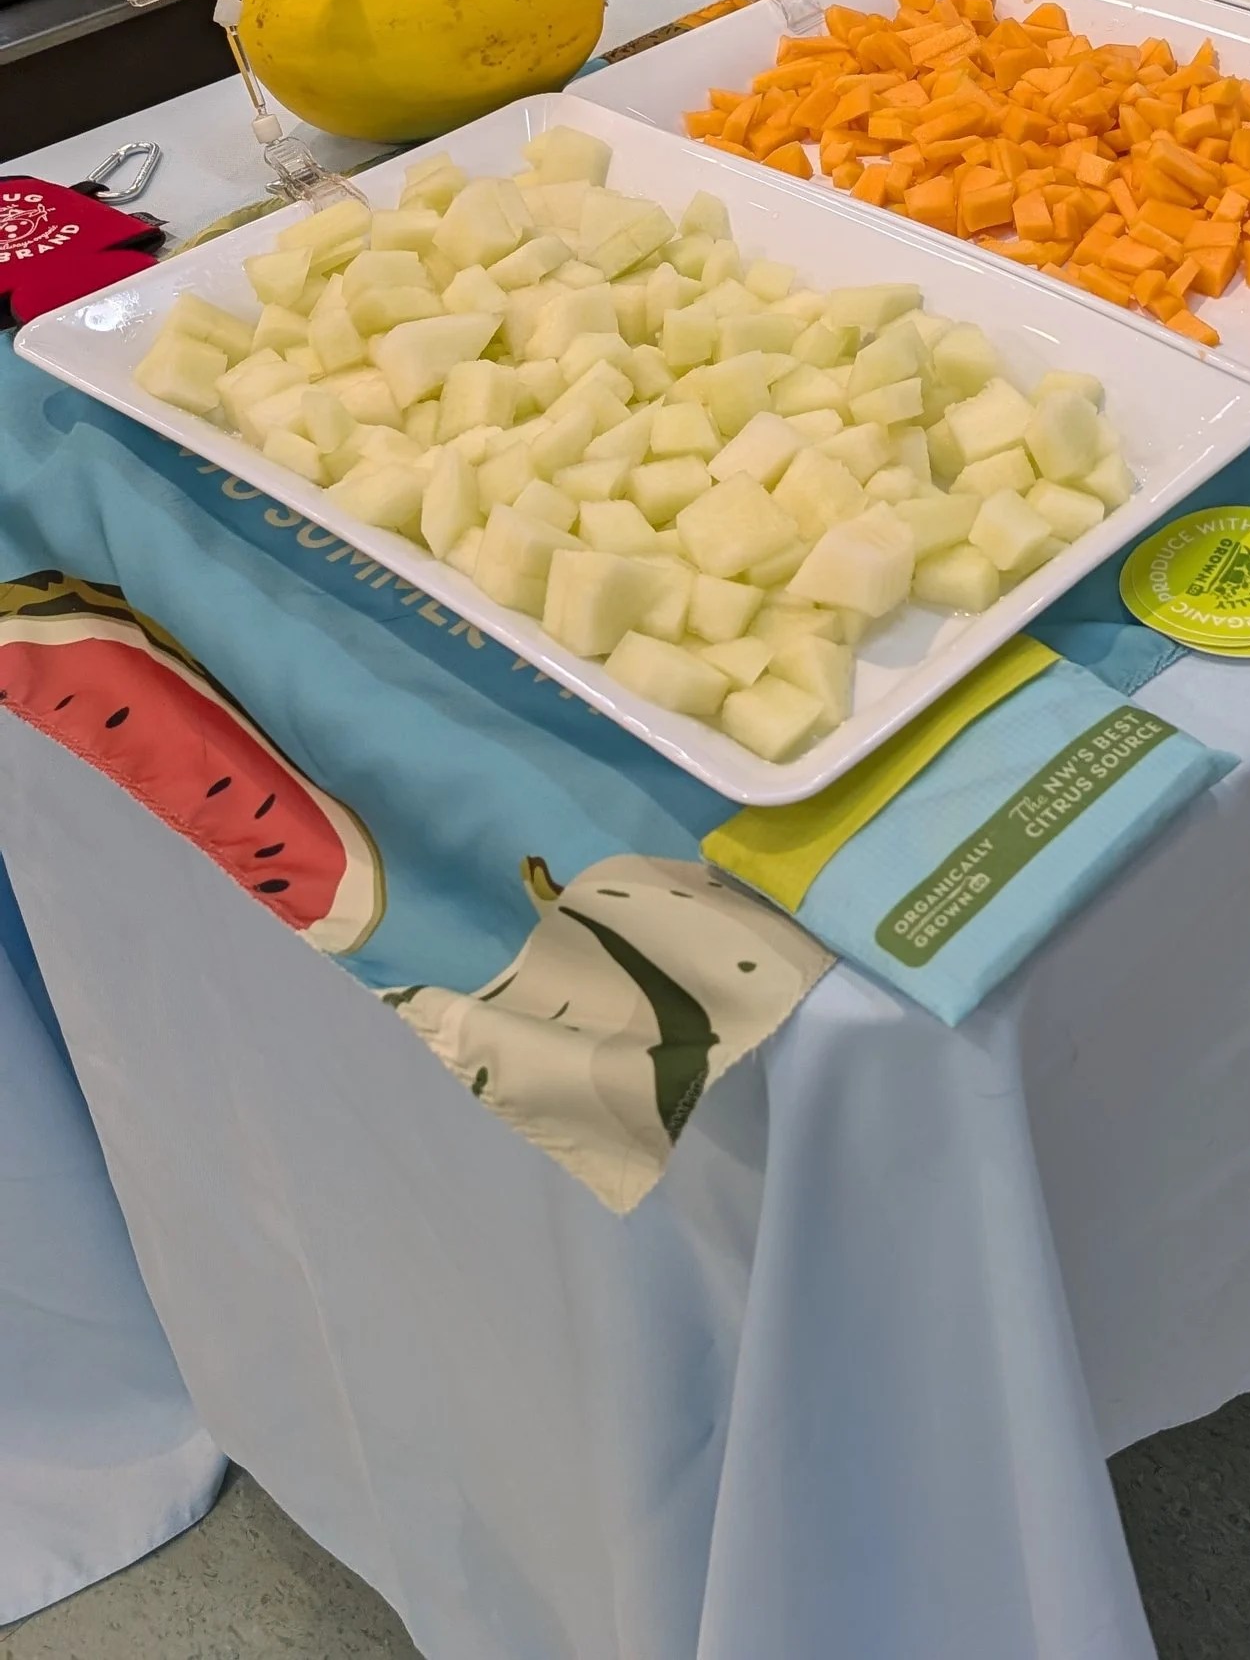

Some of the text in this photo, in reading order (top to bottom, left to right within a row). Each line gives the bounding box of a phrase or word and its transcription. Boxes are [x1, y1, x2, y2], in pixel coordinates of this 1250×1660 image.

[0, 224, 80, 263] BRAND
[1149, 529, 1194, 604] PRODUCE
[1196, 537, 1233, 591] GROWN
[1007, 712, 1141, 824] The NW'S BEST
[1024, 720, 1163, 839] CITRUS SOURCE
[893, 838, 995, 936] ORGANICALLY
[913, 891, 974, 949] GROWN
